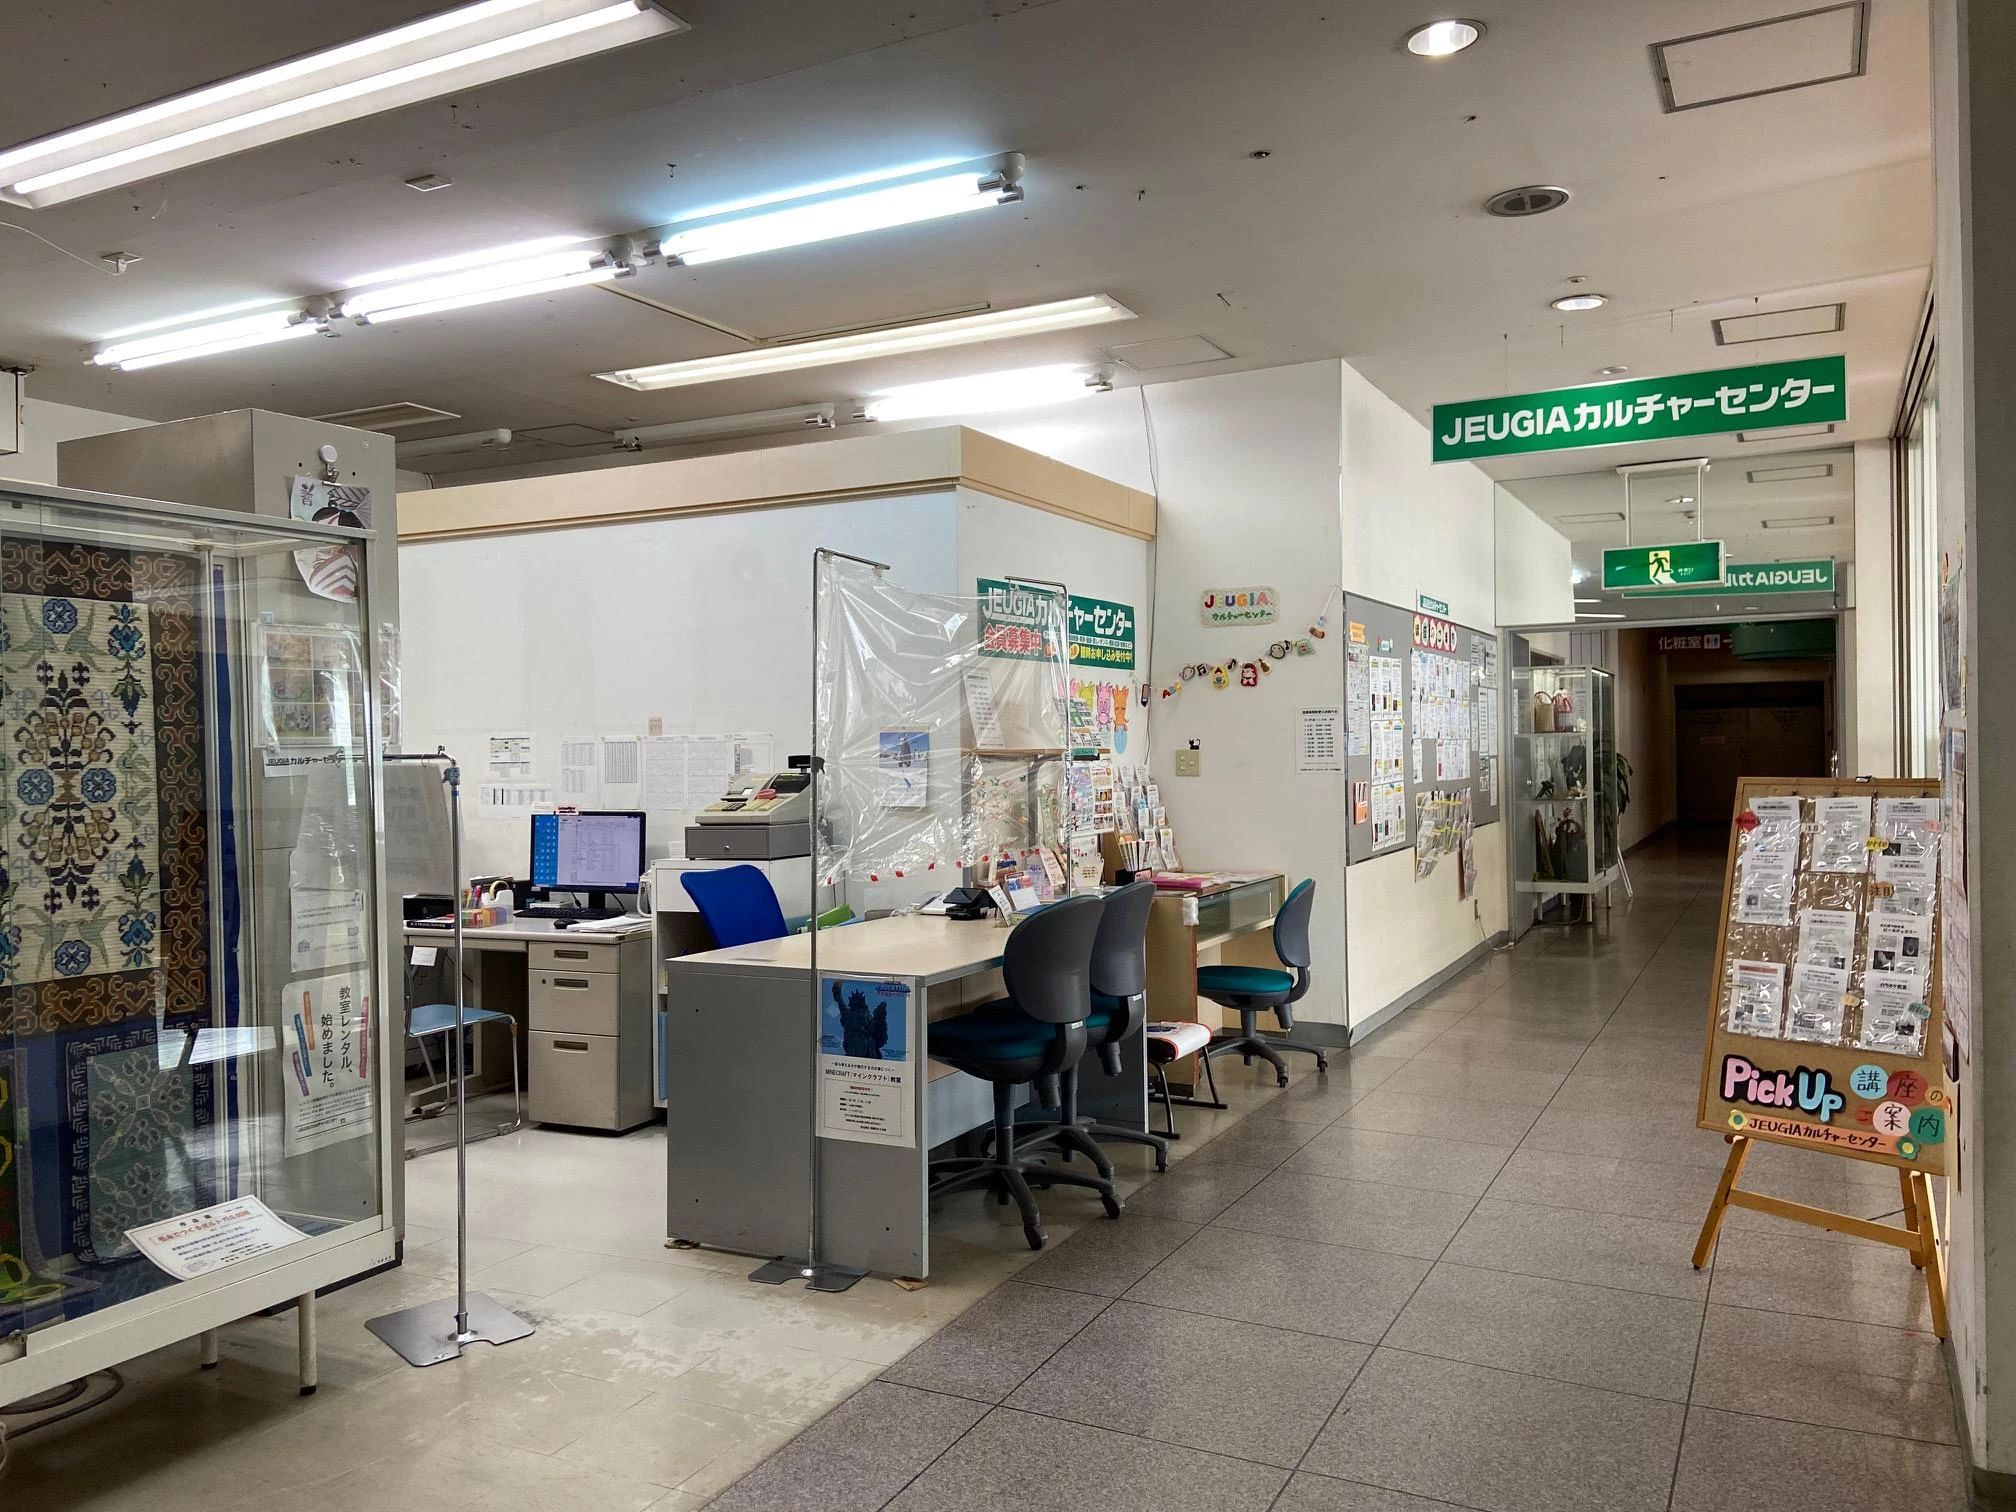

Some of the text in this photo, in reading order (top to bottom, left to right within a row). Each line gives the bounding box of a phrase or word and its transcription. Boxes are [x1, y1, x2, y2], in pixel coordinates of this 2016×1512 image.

[1441, 377, 1835, 446] JEUGIAカルチャーセンター
[1203, 591, 1270, 609] JEUGIA
[1658, 635, 1704, 650] 化粧室
[321, 1013, 335, 1088] 始めました。
[339, 986, 353, 1073] 教室レンタル、
[1724, 1057, 1843, 1122] Pick Up
[1749, 1119, 1886, 1147] JEUGIAカルチャーセンター
